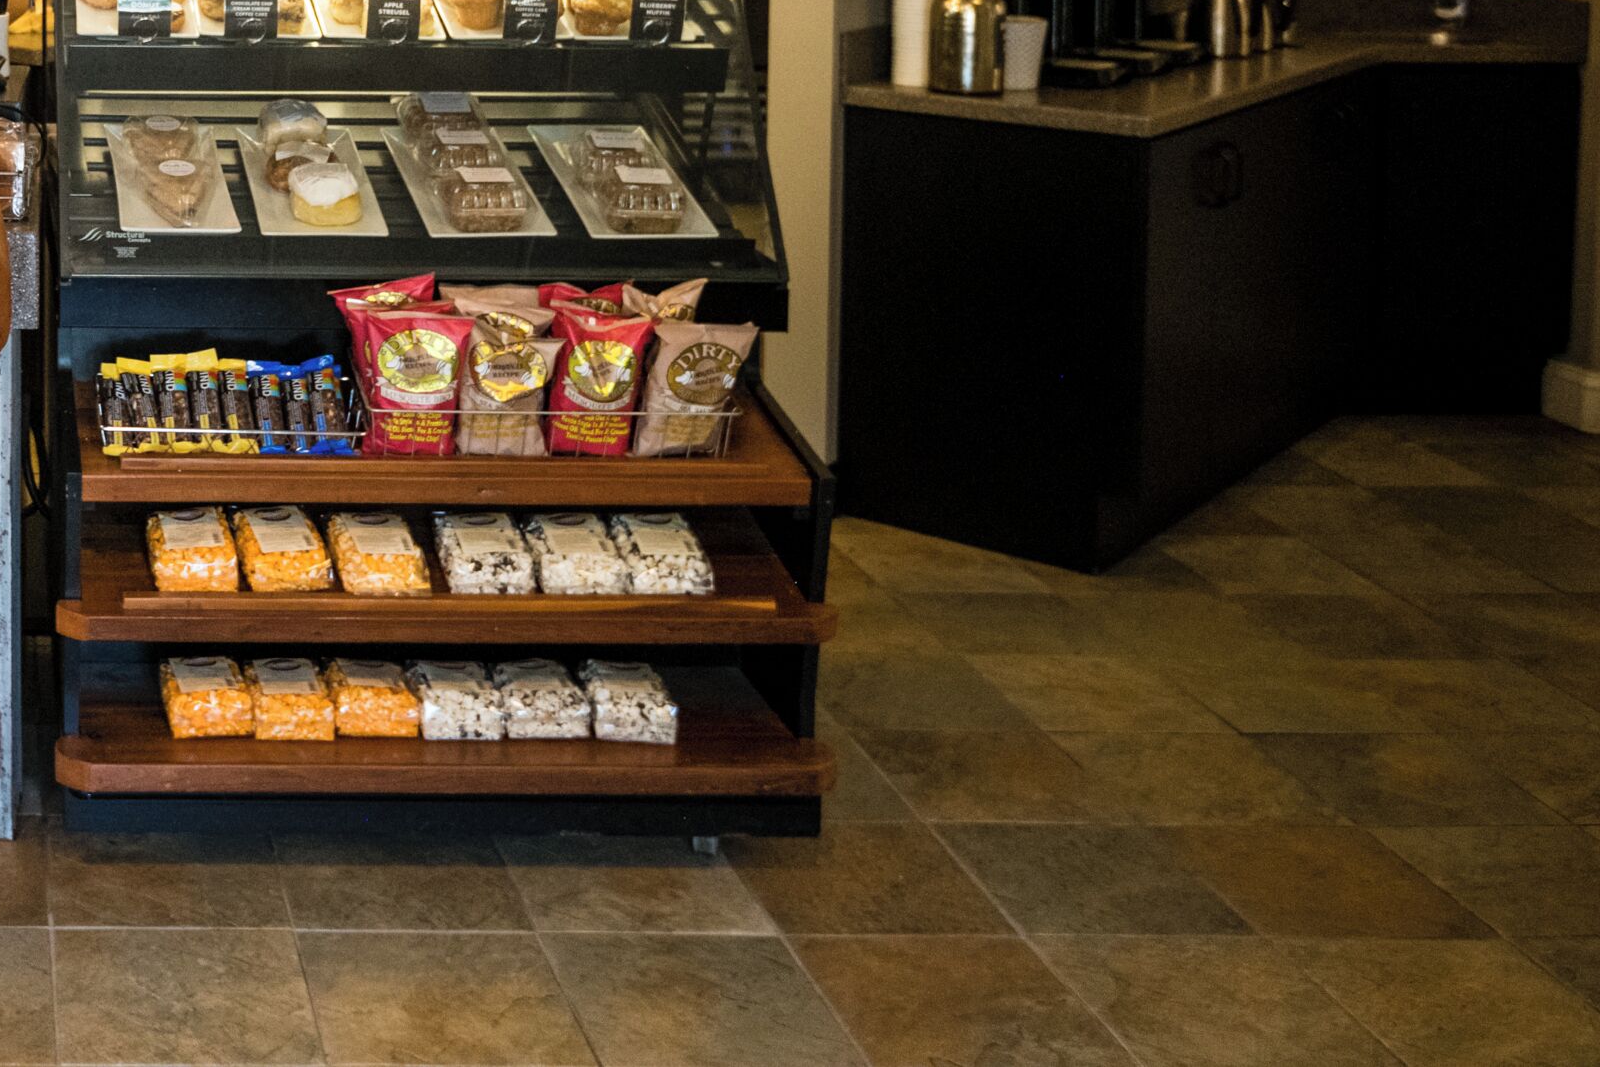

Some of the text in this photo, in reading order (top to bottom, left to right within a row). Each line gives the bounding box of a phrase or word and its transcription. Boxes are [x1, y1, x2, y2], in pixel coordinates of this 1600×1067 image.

[639, 2, 677, 10] BLUEBERRY
[105, 230, 145, 238] Structural
[676, 344, 742, 369] DIRTY
[200, 372, 210, 390] IND
[225, 370, 237, 391] KIND
[261, 374, 272, 397] KIND
[291, 378, 304, 401] KIND
[314, 371, 324, 391] IND
[115, 382, 127, 400] IND
